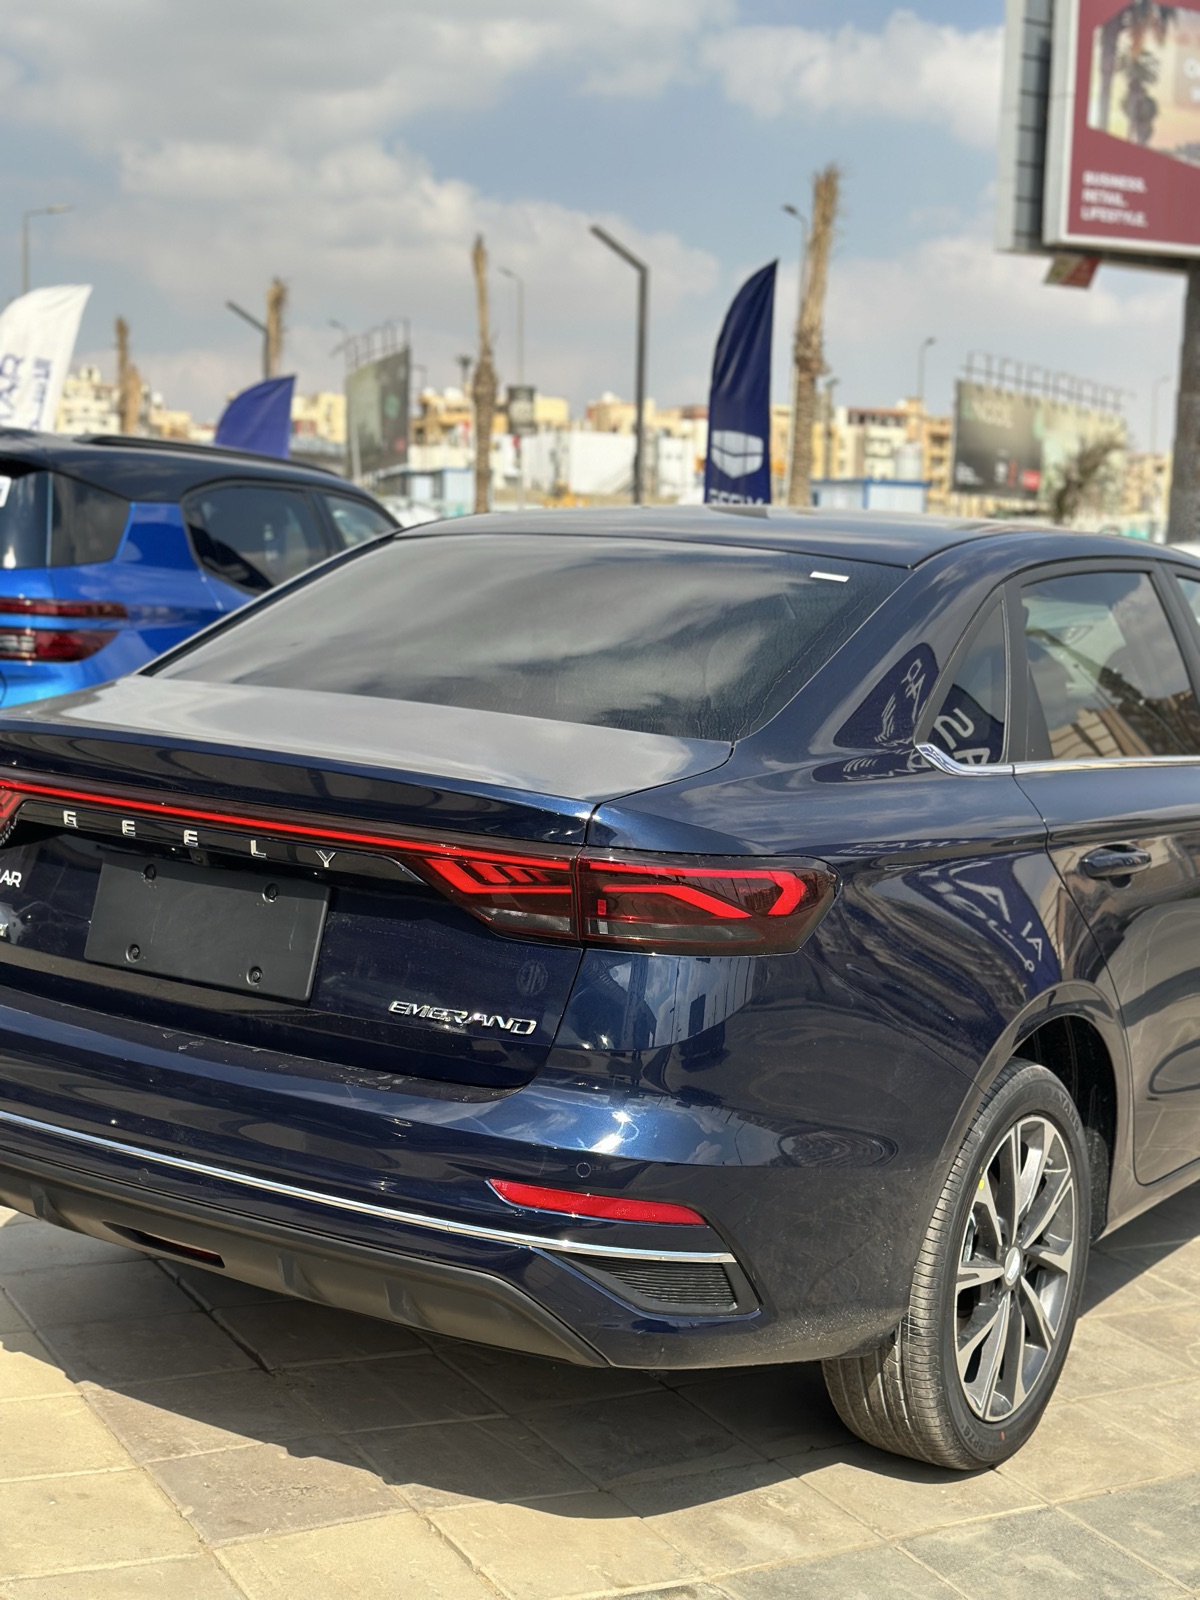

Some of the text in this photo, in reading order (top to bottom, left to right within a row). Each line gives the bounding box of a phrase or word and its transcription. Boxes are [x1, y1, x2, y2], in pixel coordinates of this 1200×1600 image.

[63, 809, 337, 868] GEELY
[0, 868, 22, 888] AR
[388, 1000, 538, 1036] EMGRAND
